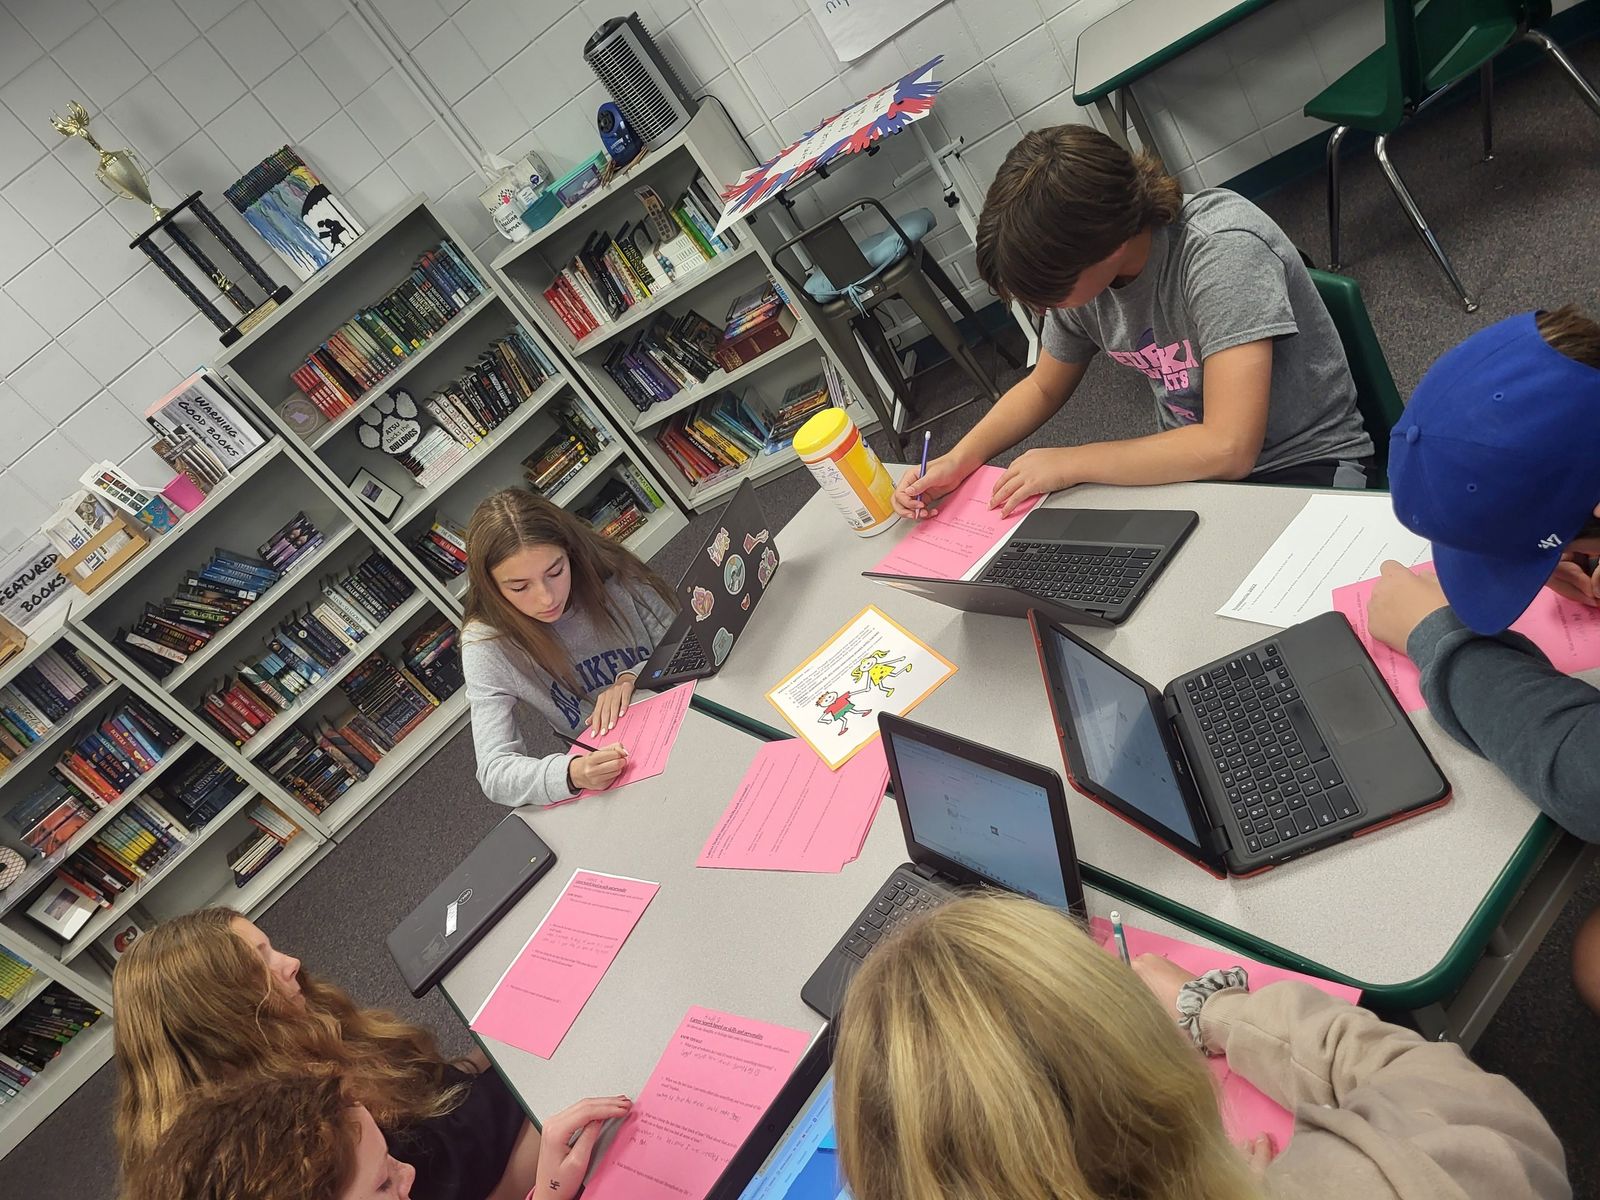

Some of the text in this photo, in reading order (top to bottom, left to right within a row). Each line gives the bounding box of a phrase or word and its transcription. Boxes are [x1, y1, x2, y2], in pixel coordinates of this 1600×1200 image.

[177, 400, 206, 427] GOOD
[206, 426, 239, 457] BOOKS
[194, 395, 238, 438] WARNING
[386, 421, 400, 435] ATSU
[385, 422, 410, 443] backs the
[389, 427, 418, 452] BULLDOGS
[1537, 533, 1562, 548] '47
[0, 551, 59, 606] FEATURED
[20, 572, 67, 612] BOOKS
[339, 610, 360, 631] LEGEND
